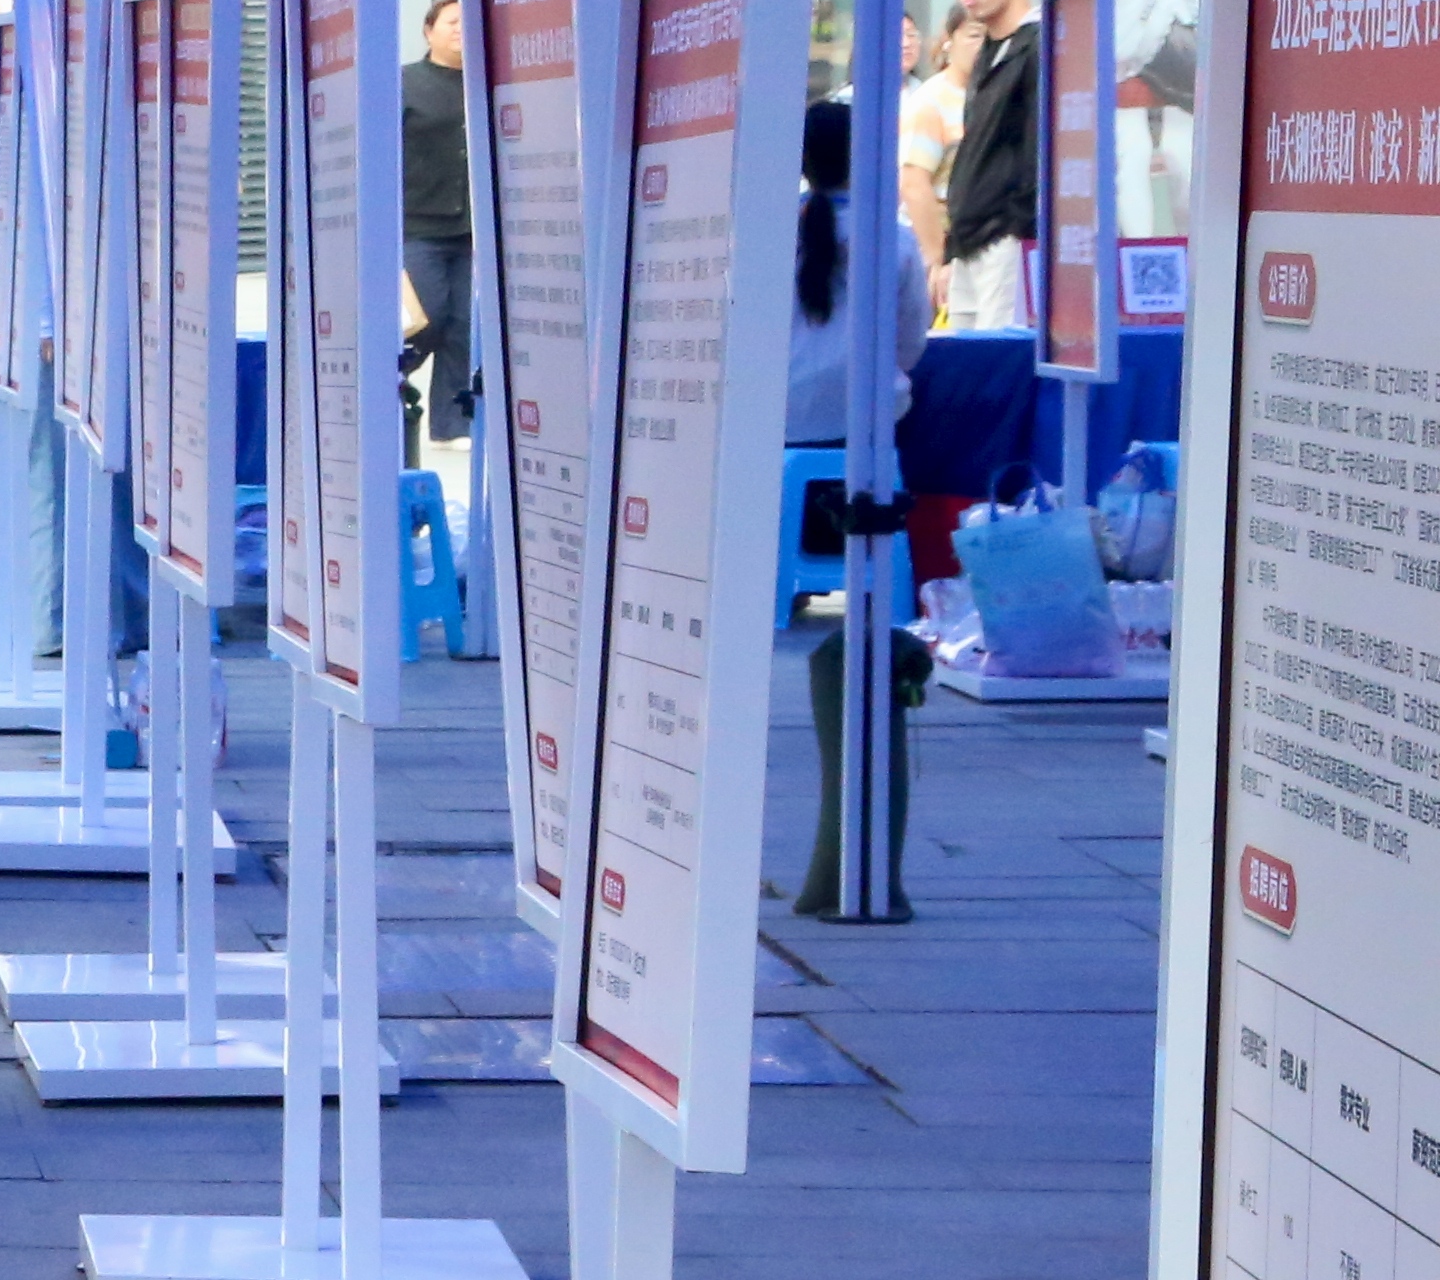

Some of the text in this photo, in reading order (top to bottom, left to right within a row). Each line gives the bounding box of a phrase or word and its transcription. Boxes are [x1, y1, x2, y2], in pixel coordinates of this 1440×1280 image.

[1268, 264, 1309, 306] 公司简介
[1248, 856, 1289, 913] 招聘岗位
